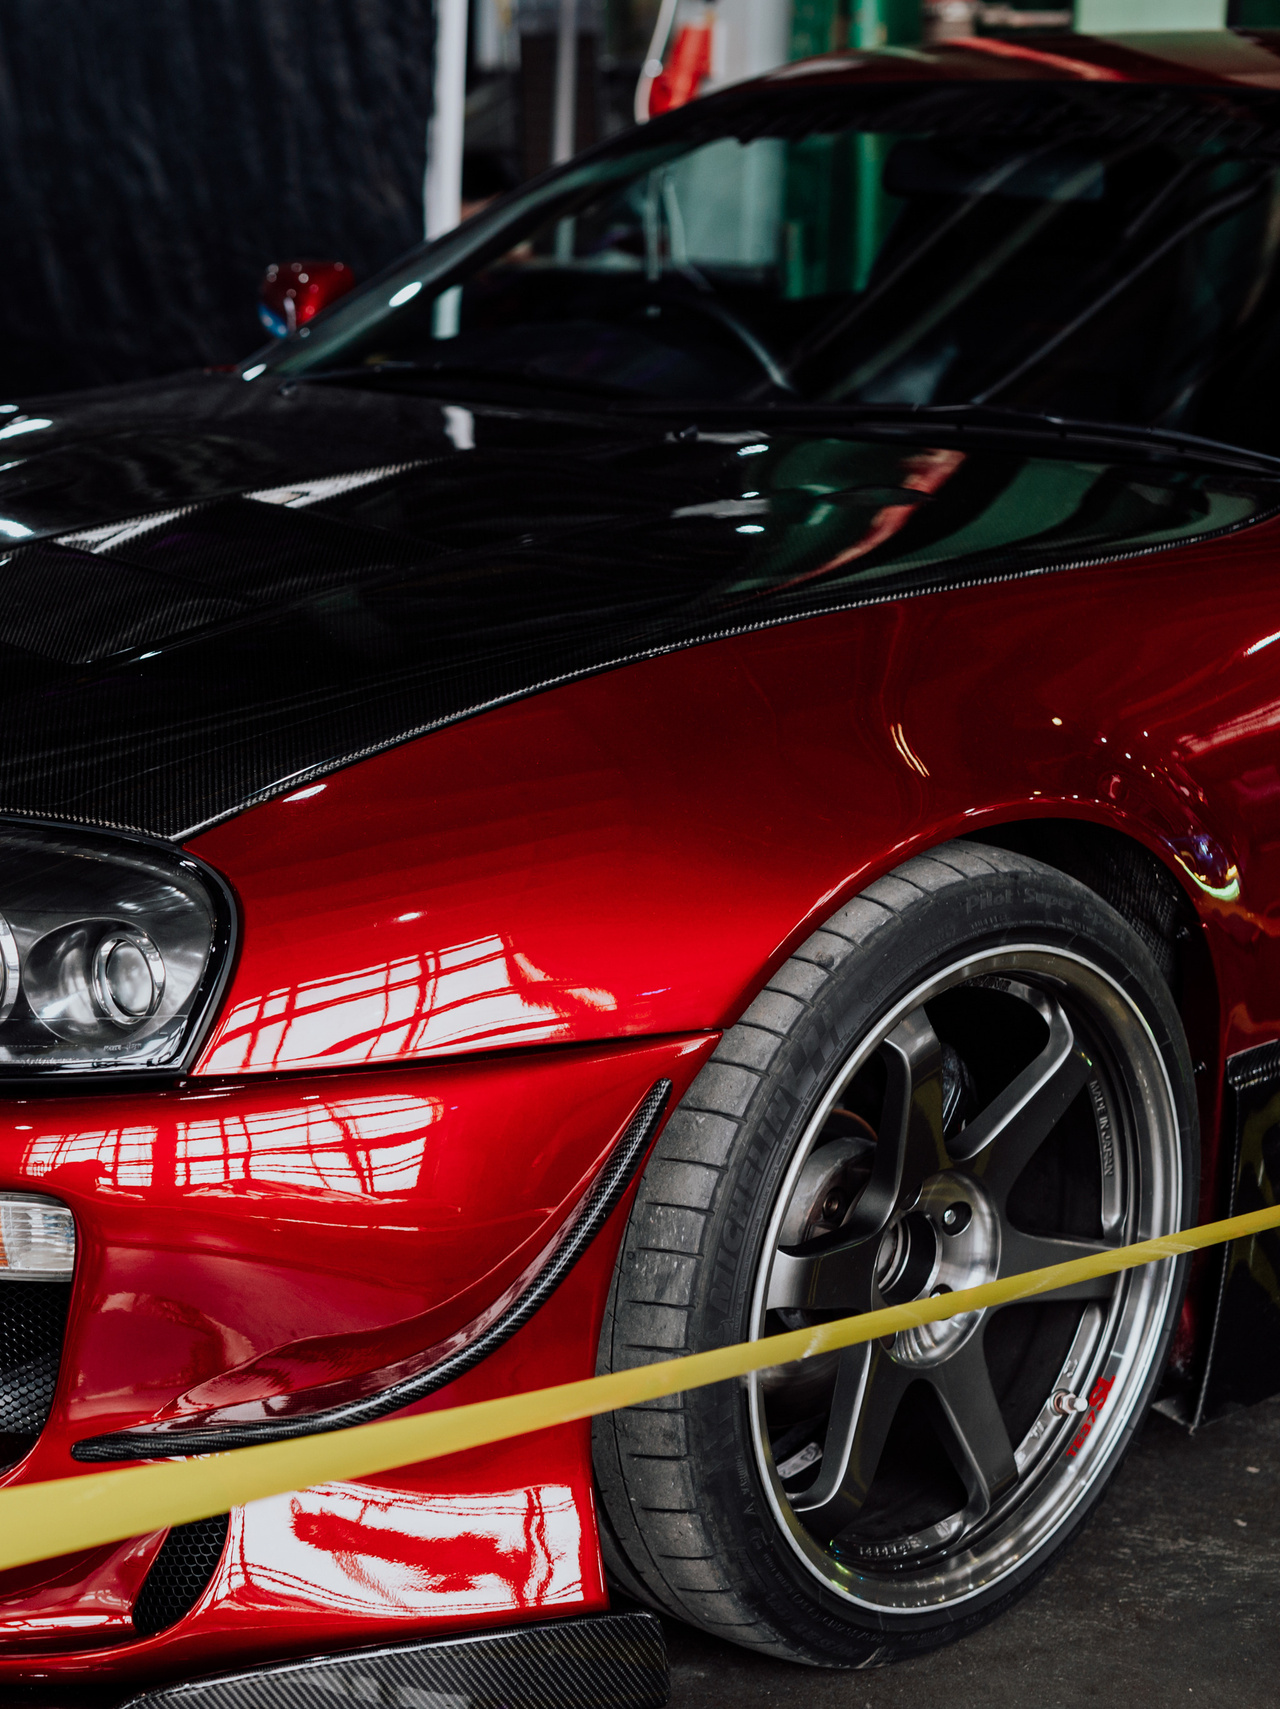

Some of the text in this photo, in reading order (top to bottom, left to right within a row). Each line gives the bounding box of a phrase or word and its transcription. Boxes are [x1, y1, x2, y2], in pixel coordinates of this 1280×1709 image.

[966, 888, 1013, 914] Pilot
[1023, 887, 1076, 910] Super
[1089, 1079, 1115, 1176] MADE IN JAPAN
[709, 1086, 793, 1315] MICHELIN
